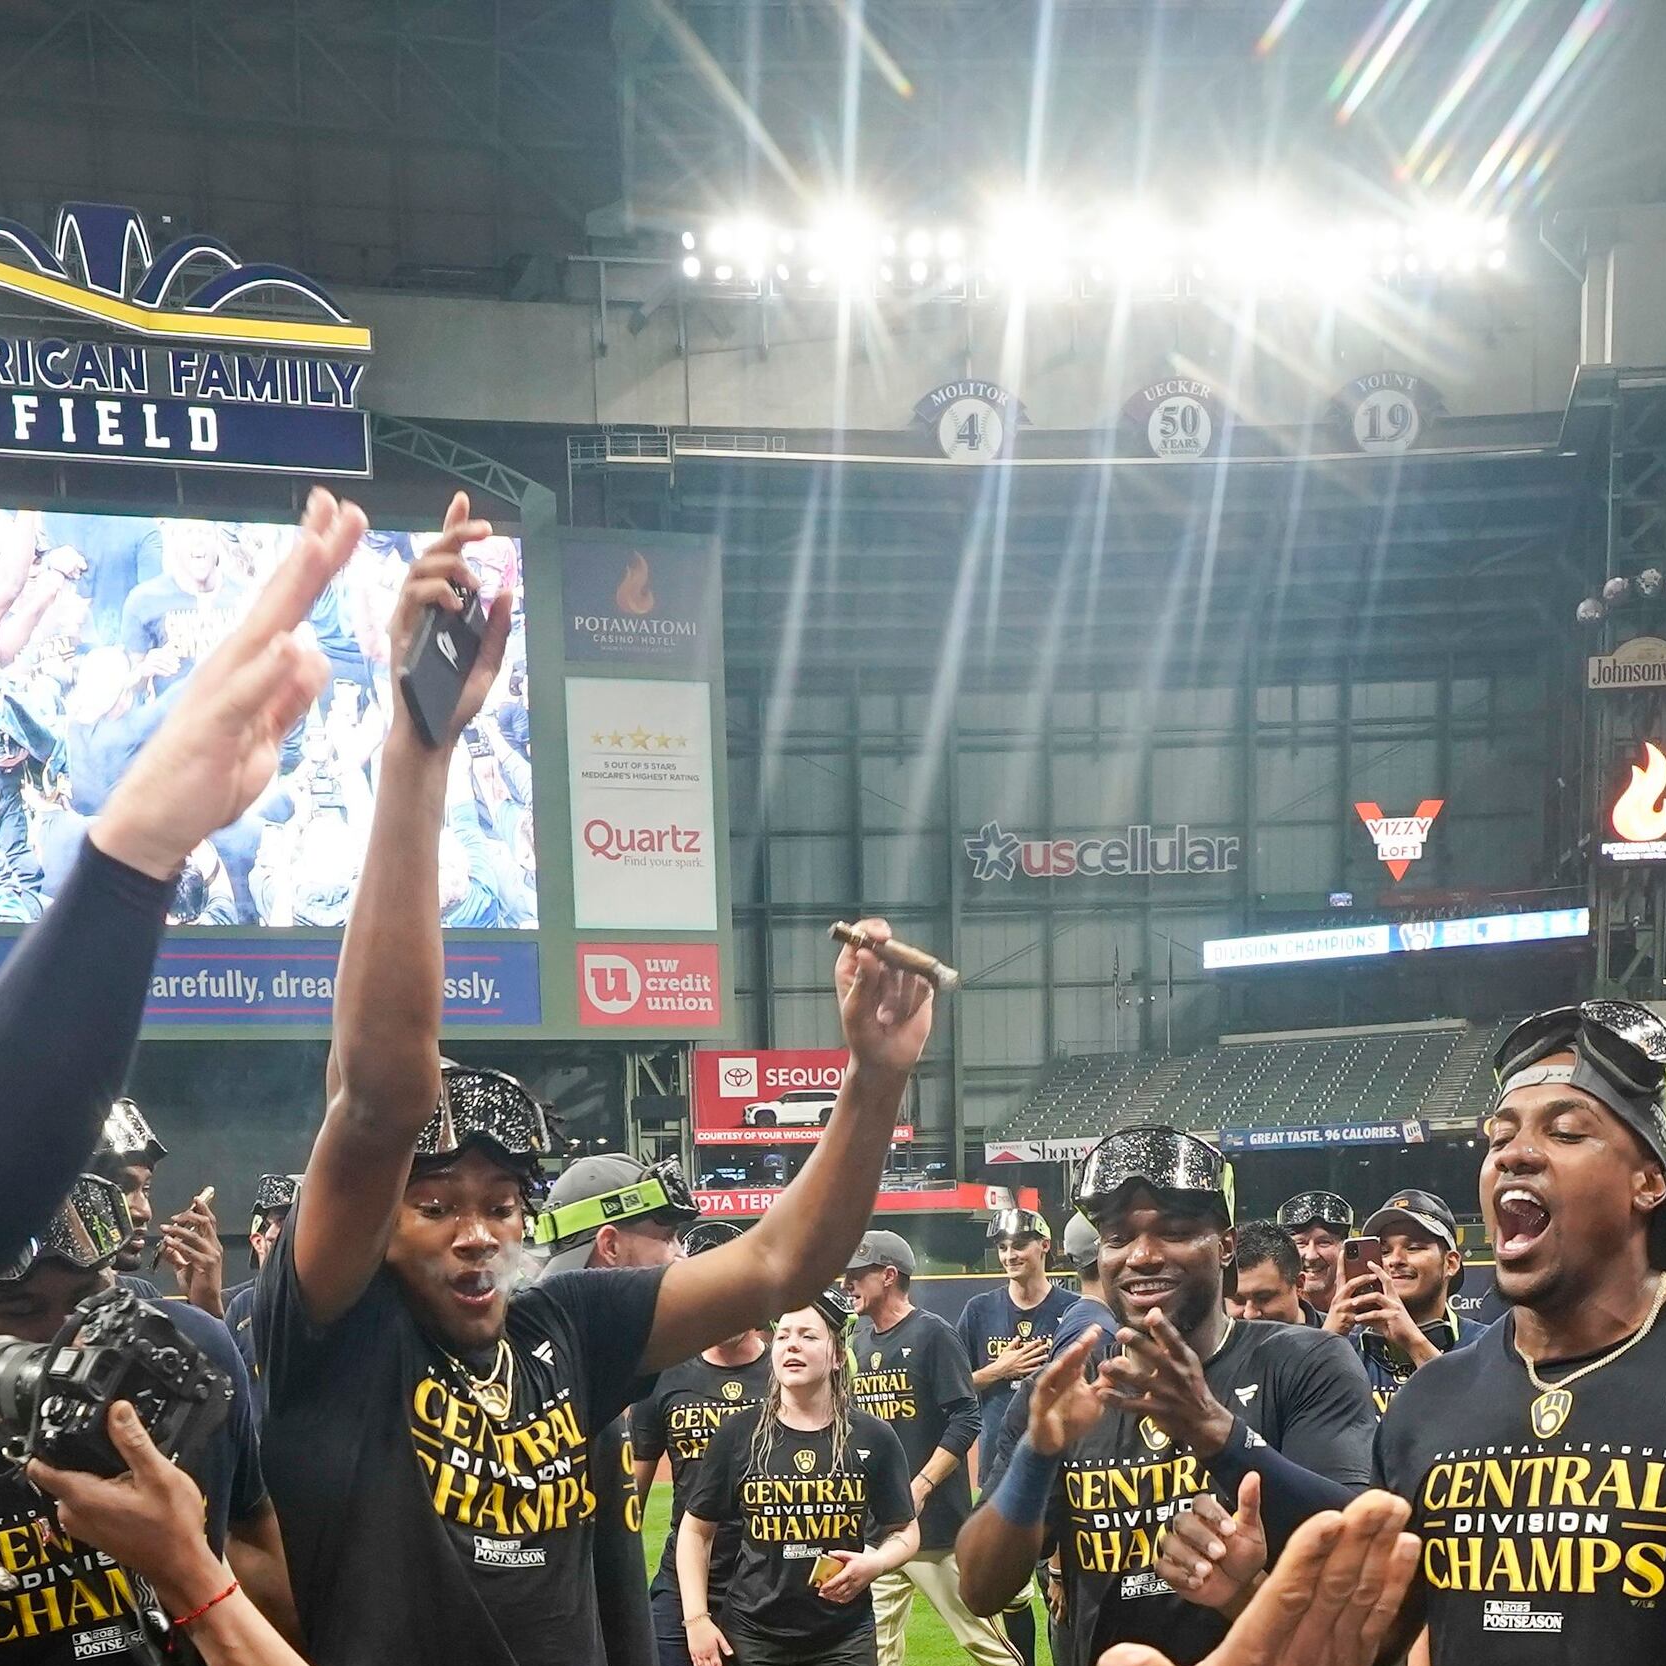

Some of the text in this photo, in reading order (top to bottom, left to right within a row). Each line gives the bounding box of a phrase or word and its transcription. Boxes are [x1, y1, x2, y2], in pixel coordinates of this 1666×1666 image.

[170, 350, 366, 409] FAMILY
[1356, 373, 1419, 393] YOUNT
[930, 381, 1011, 407] MOLITOR
[1143, 379, 1212, 402] UECKER
[12, 395, 218, 452] FIELD
[1159, 405, 1199, 437] 50
[1362, 401, 1413, 444] 19
[955, 412, 983, 451] 4
[1160, 438, 1200, 449] YEARS
[574, 616, 698, 637] POTAWATOMI
[593, 634, 677, 647] CASINO HOTEL
[611, 761, 628, 770] OUT
[630, 761, 642, 771] OF
[651, 762, 677, 772] STARS
[633, 772, 667, 782] HIGHEST
[669, 773, 700, 782] RATING
[1369, 819, 1432, 837] VIZZY
[584, 818, 701, 861] Quartz
[624, 855, 647, 867] Find
[649, 857, 677, 869] your
[1380, 845, 1421, 859] LOFT
[1213, 928, 1378, 963] DIVISION CHAMPIONS
[645, 958, 679, 973] uw
[148, 969, 333, 1001] arefully, drea
[645, 973, 711, 993] credit
[645, 993, 714, 1012] union
[765, 1067, 847, 1088] SEQUOI
[697, 1129, 824, 1141] COURTESY OF YOUR WISCONS
[1250, 1132, 1289, 1146] GREAT
[1292, 1130, 1323, 1144] TASTE.
[1325, 1128, 1340, 1142] 96
[1342, 1126, 1401, 1142] CALORIES.
[693, 1193, 734, 1212] OTA
[853, 1372, 913, 1396] ENTRAL
[1434, 1443, 1545, 1461] NATIONAL
[450, 1447, 572, 1490] DIVISION
[743, 1478, 866, 1505] CENTRAL
[1066, 1455, 1212, 1512] CENTR
[764, 1504, 848, 1516] DIVISION
[751, 1513, 863, 1542] CHAMPS
[1454, 1511, 1610, 1535] DIVISION
[475, 1549, 547, 1566] POSTSEASON
[23, 1551, 117, 1590] DIVIS
[1503, 1602, 1532, 1613] 2023
[1483, 1614, 1564, 1630] POSTSEASON
[92, 1626, 122, 1640] 2023
